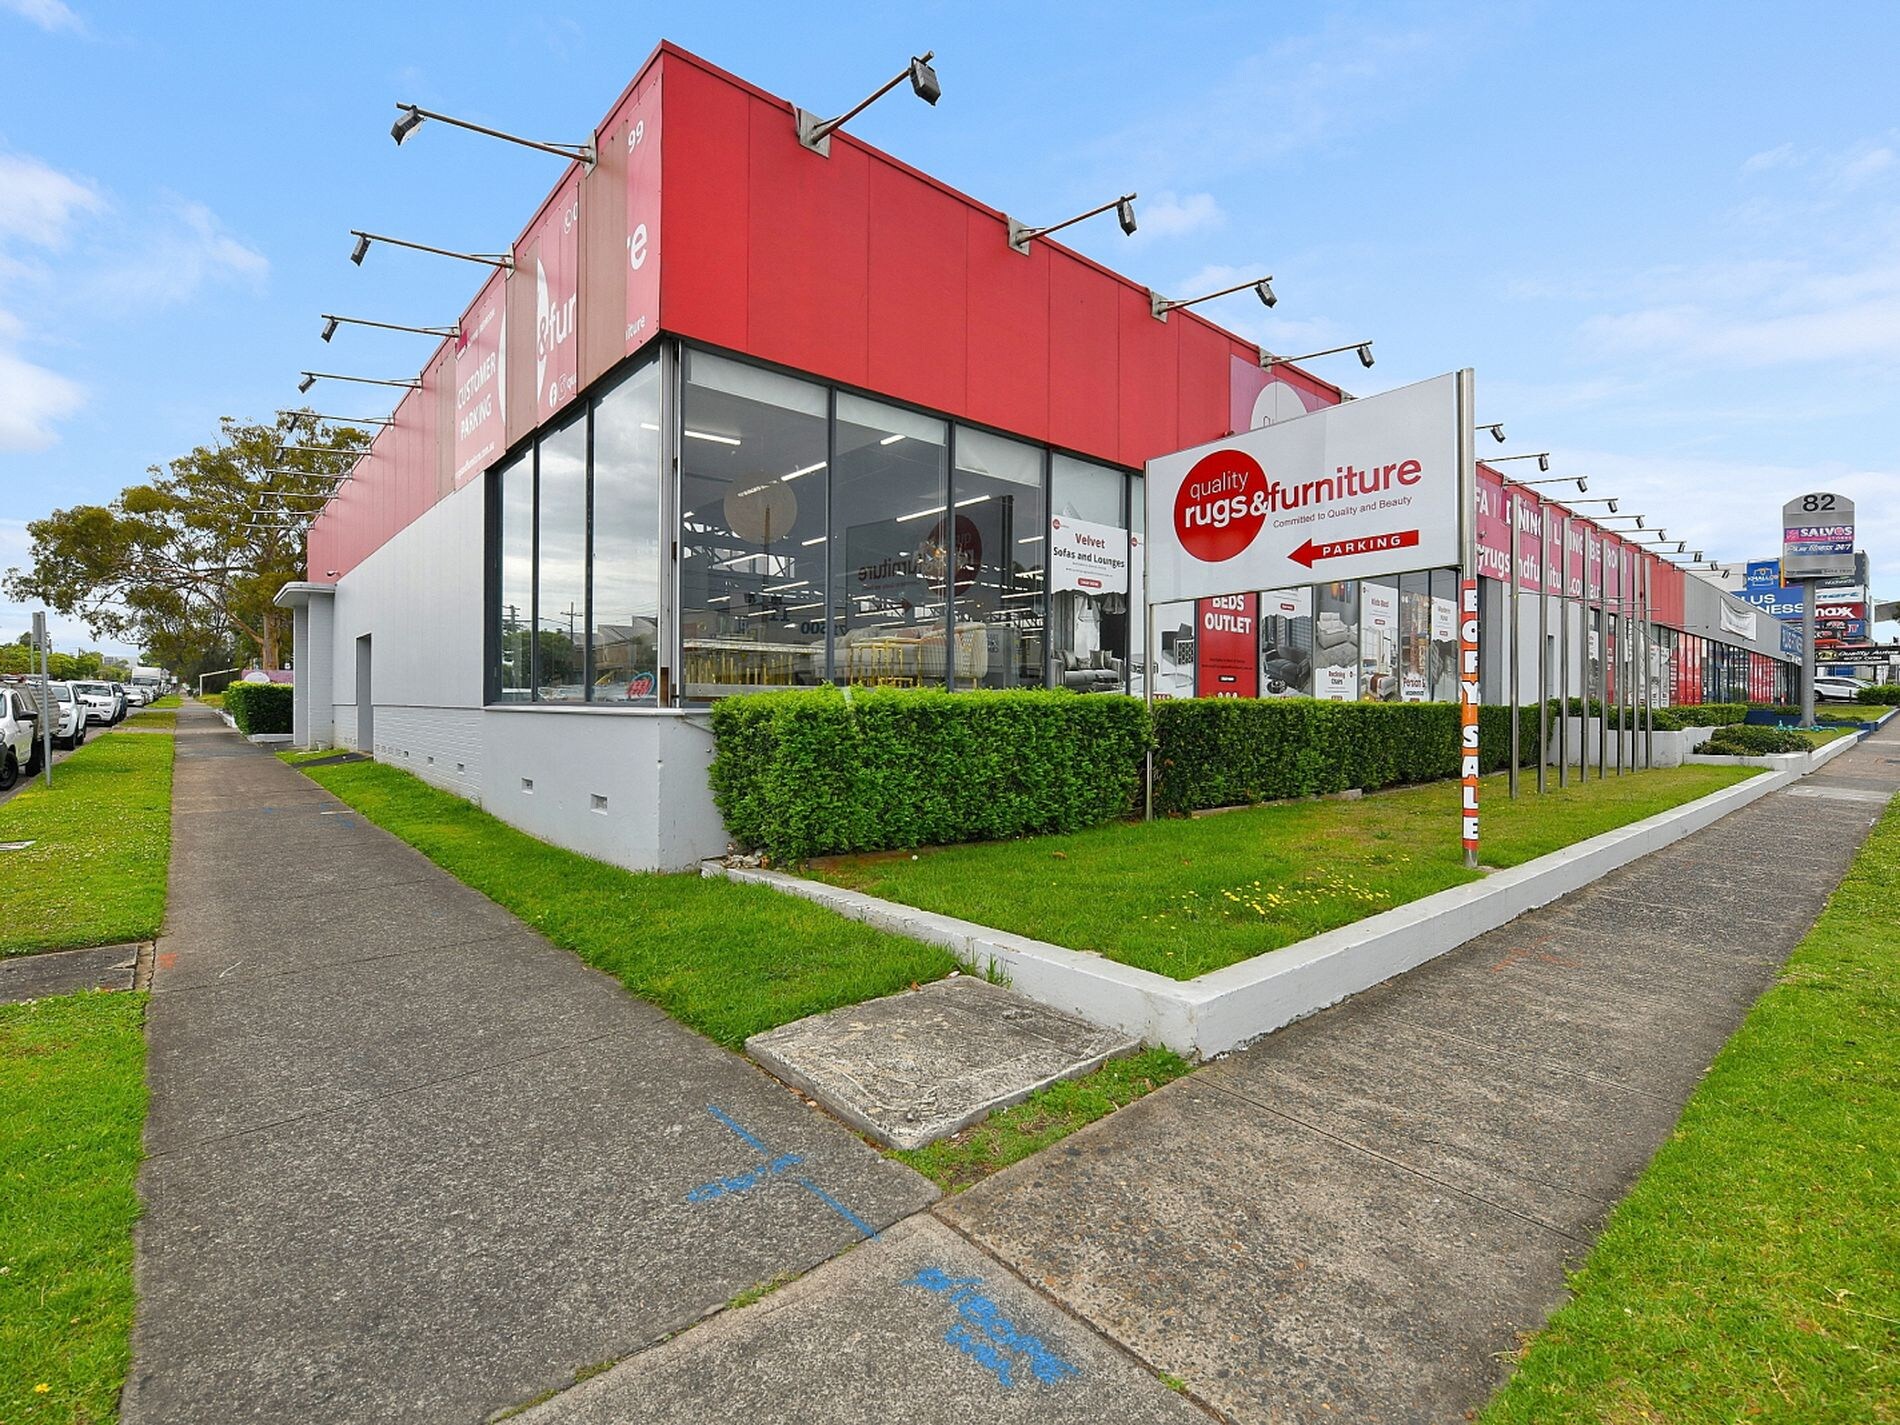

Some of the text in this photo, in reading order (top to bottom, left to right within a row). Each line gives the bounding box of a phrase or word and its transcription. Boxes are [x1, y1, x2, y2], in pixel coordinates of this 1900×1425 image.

[1190, 470, 1249, 501] quality
[1273, 495, 1413, 529] Committed to Quality and Beauty
[1802, 494, 1836, 512] 82
[1075, 533, 1106, 549] Velvet
[1800, 526, 1853, 537] SALVOS
[1322, 535, 1402, 557] PARKING
[1053, 546, 1076, 559] Sofas
[1077, 552, 1092, 562] and
[1094, 554, 1125, 569] Lounges
[1212, 594, 1245, 611] BEDS
[1204, 612, 1252, 634] OUTLET
[1462, 724, 1479, 840] SALE
